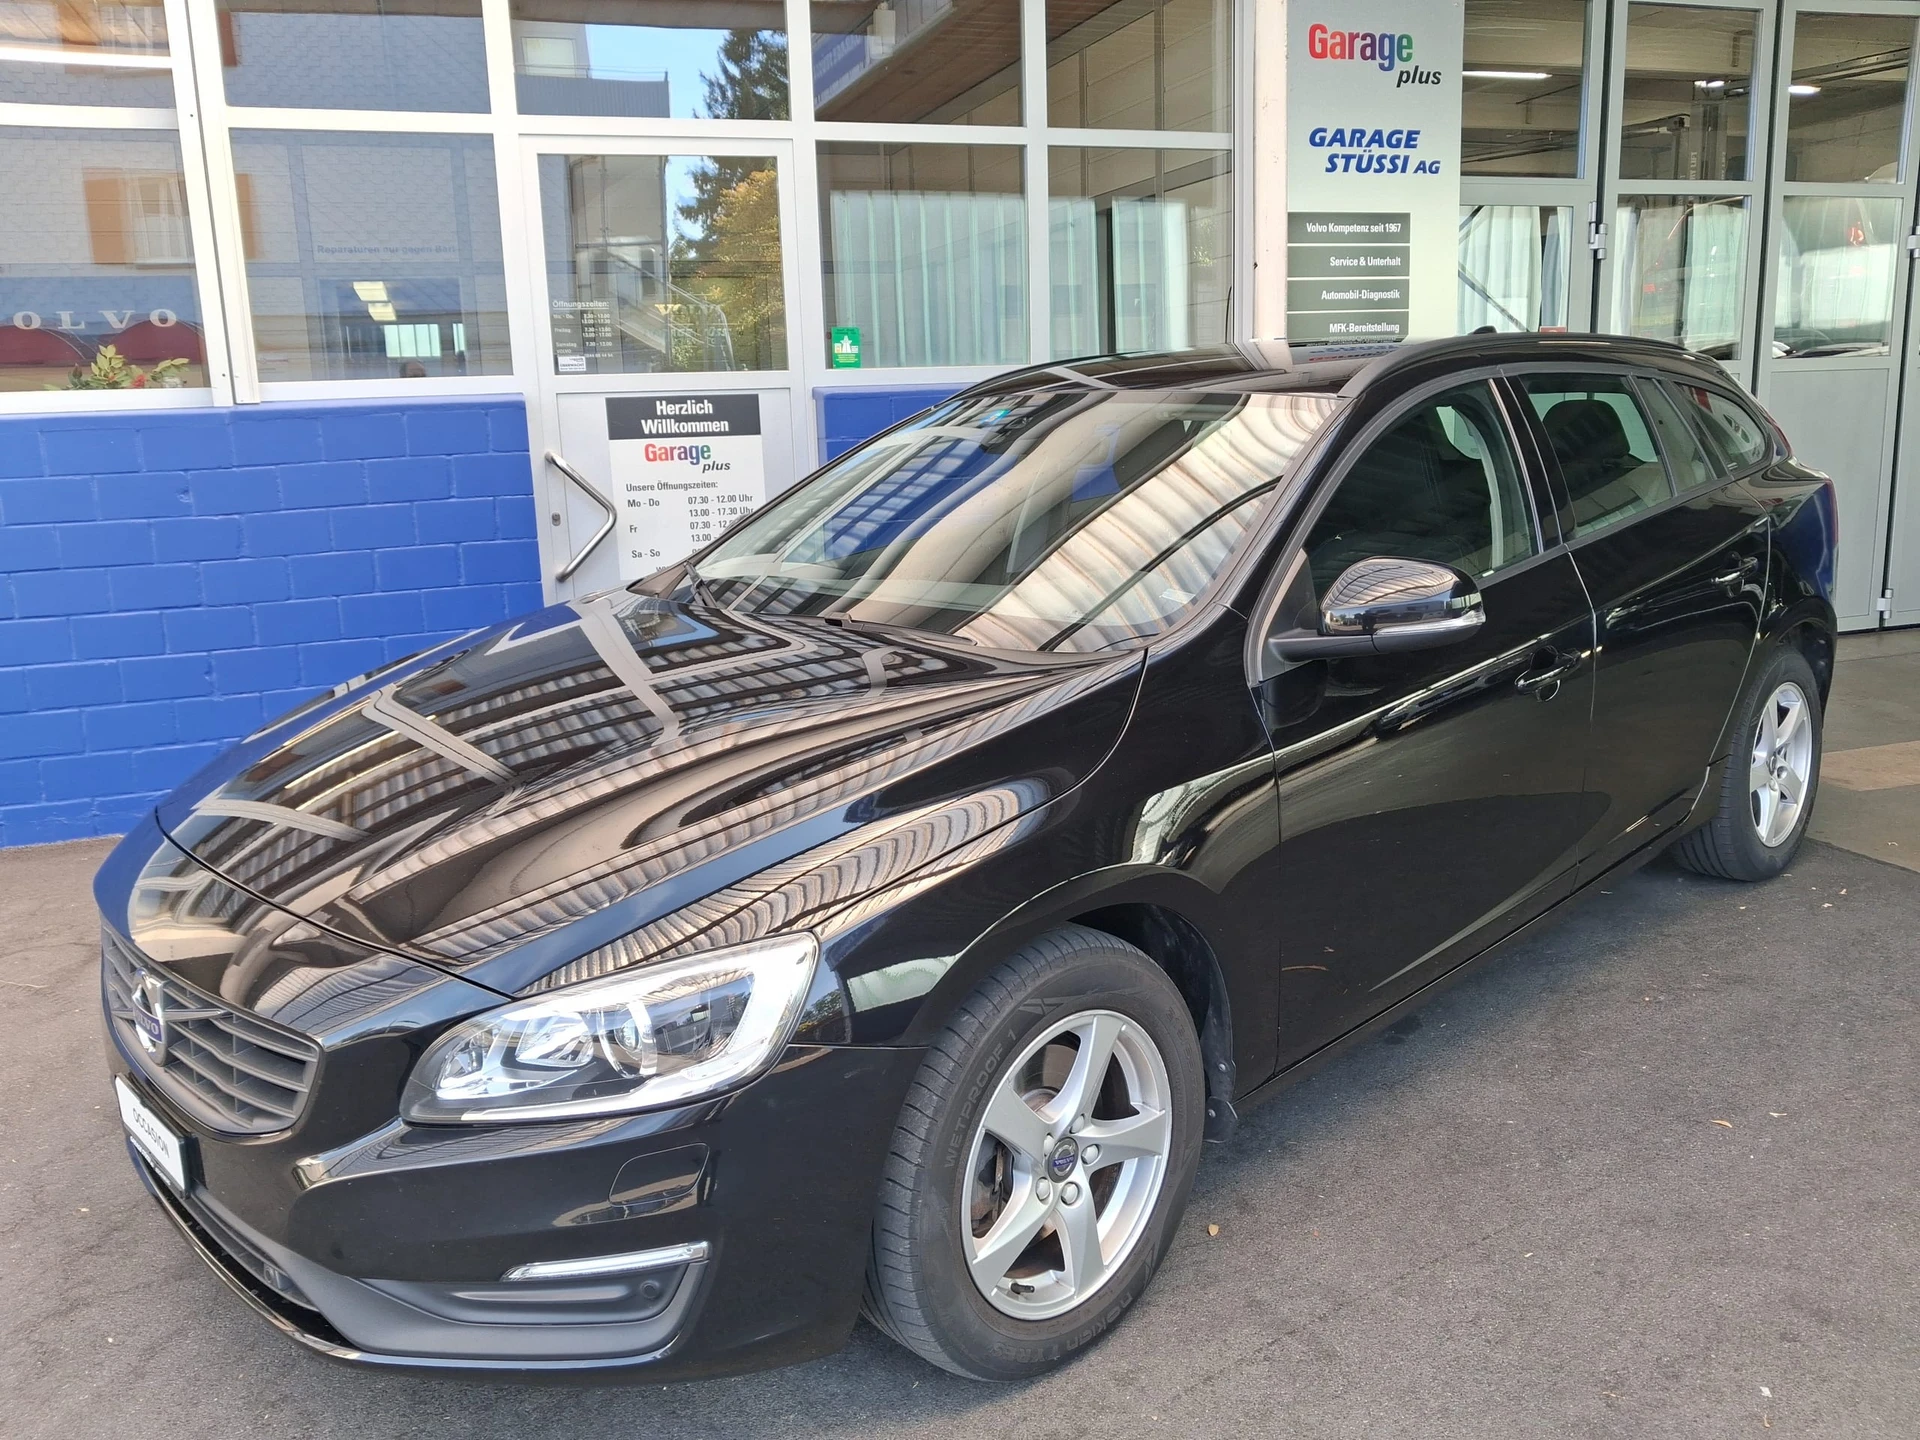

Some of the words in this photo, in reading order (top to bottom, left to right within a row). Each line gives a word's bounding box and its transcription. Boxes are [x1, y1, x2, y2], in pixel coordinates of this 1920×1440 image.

[1308, 24, 1414, 72] Garage
[1396, 66, 1442, 88] plus
[1308, 127, 1420, 149] GARAGE
[1325, 150, 1410, 174] STÜSSI
[1413, 160, 1440, 174] AG
[1306, 222, 1328, 234] Volvo
[1328, 222, 1369, 236] Kompetenz
[1370, 222, 1384, 233] seit
[1385, 222, 1401, 233] 1967
[317, 245, 380, 254] Reparaturen
[402, 246, 432, 255] gegen
[1330, 256, 1358, 267] Service
[1359, 257, 1366, 267] &
[1368, 256, 1401, 267] Unterhalt
[1322, 289, 1400, 302] Automobil-Diagnostik
[552, 300, 609, 309] Öffnungszeiten:
[1329, 322, 1400, 334] MFK-Bereitstellung
[656, 399, 713, 416] Herzlich
[641, 419, 729, 435] Willkommen
[644, 443, 711, 465] Garage
[702, 460, 731, 474] plus
[626, 483, 655, 492] Unsere
[657, 480, 718, 491] Öffnungszeiten:
[628, 499, 641, 508] Mo
[649, 498, 660, 507] Do
[688, 496, 709, 504] 07.30
[717, 495, 736, 503] 12.00
[738, 494, 753, 502] Uhr
[689, 509, 709, 517] 13.00
[718, 507, 737, 516] 17.30
[629, 525, 638, 533] Fr
[690, 521, 711, 530] 07.30
[691, 534, 711, 542] 13.00
[631, 550, 643, 558] Sa
[649, 549, 660, 557] So
[943, 1043, 1005, 1168] WETPROOF
[132, 1107, 170, 1158] OCCASION
[1055, 1156, 1074, 1165] VOLVO
